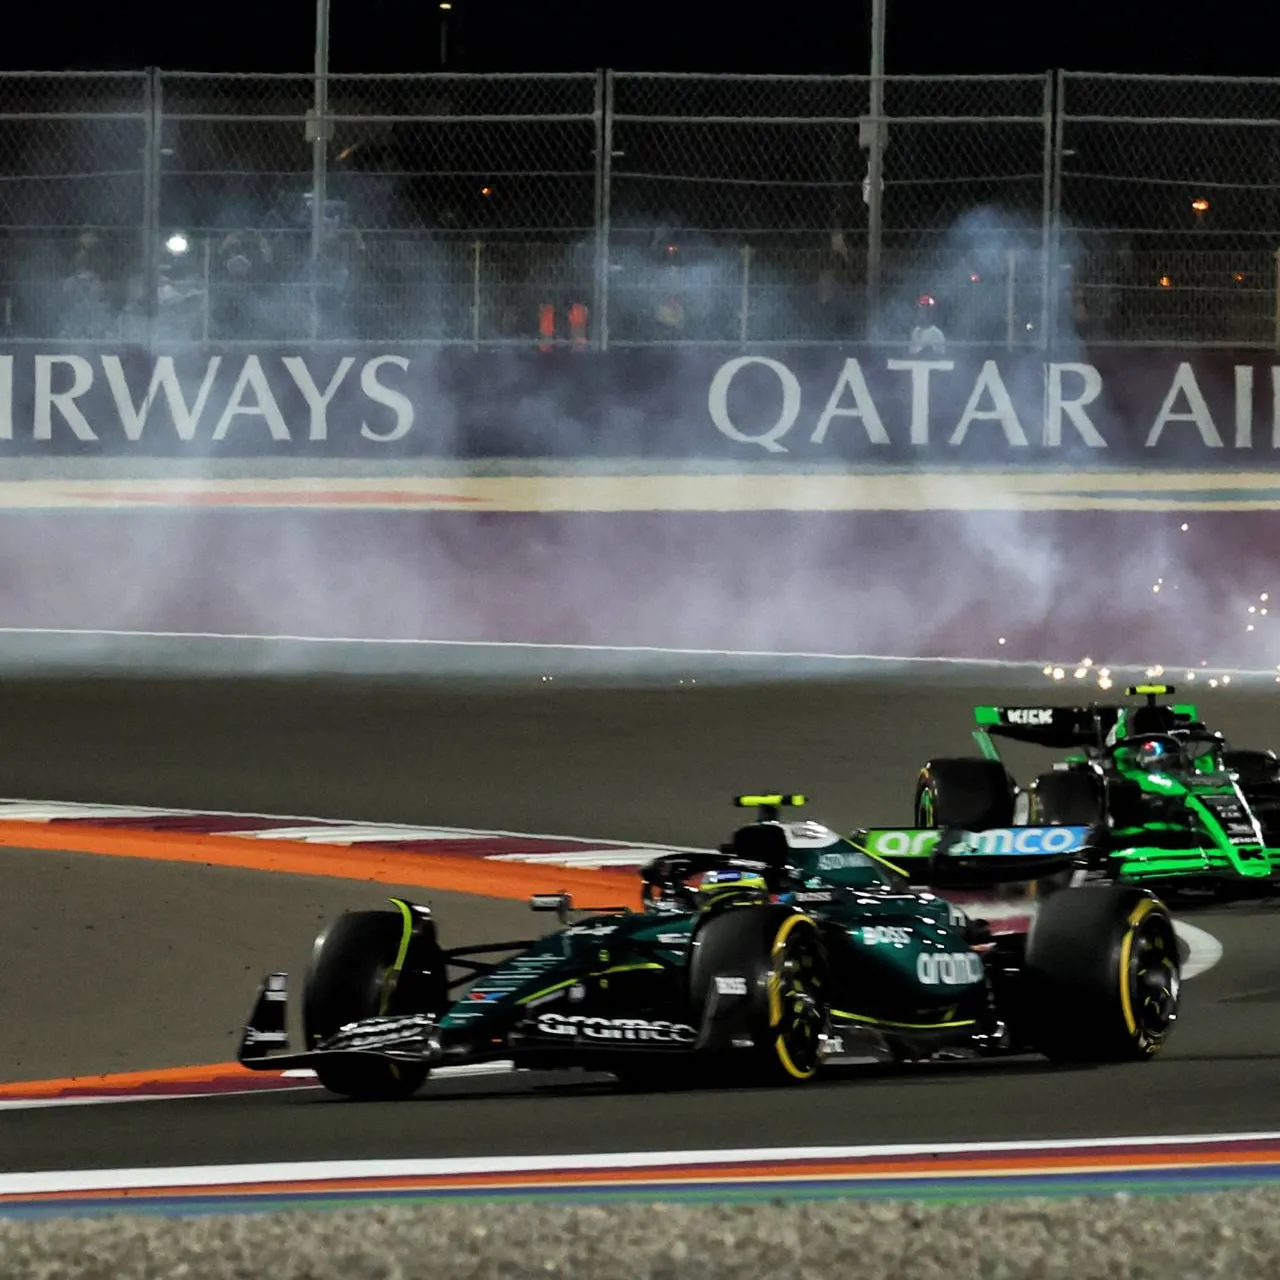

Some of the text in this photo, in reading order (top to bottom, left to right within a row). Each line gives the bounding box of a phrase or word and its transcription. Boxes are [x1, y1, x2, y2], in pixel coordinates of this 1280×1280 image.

[707, 355, 1105, 455] QATAR
[1007, 709, 1053, 724] KICK
[876, 827, 1075, 856] armco
